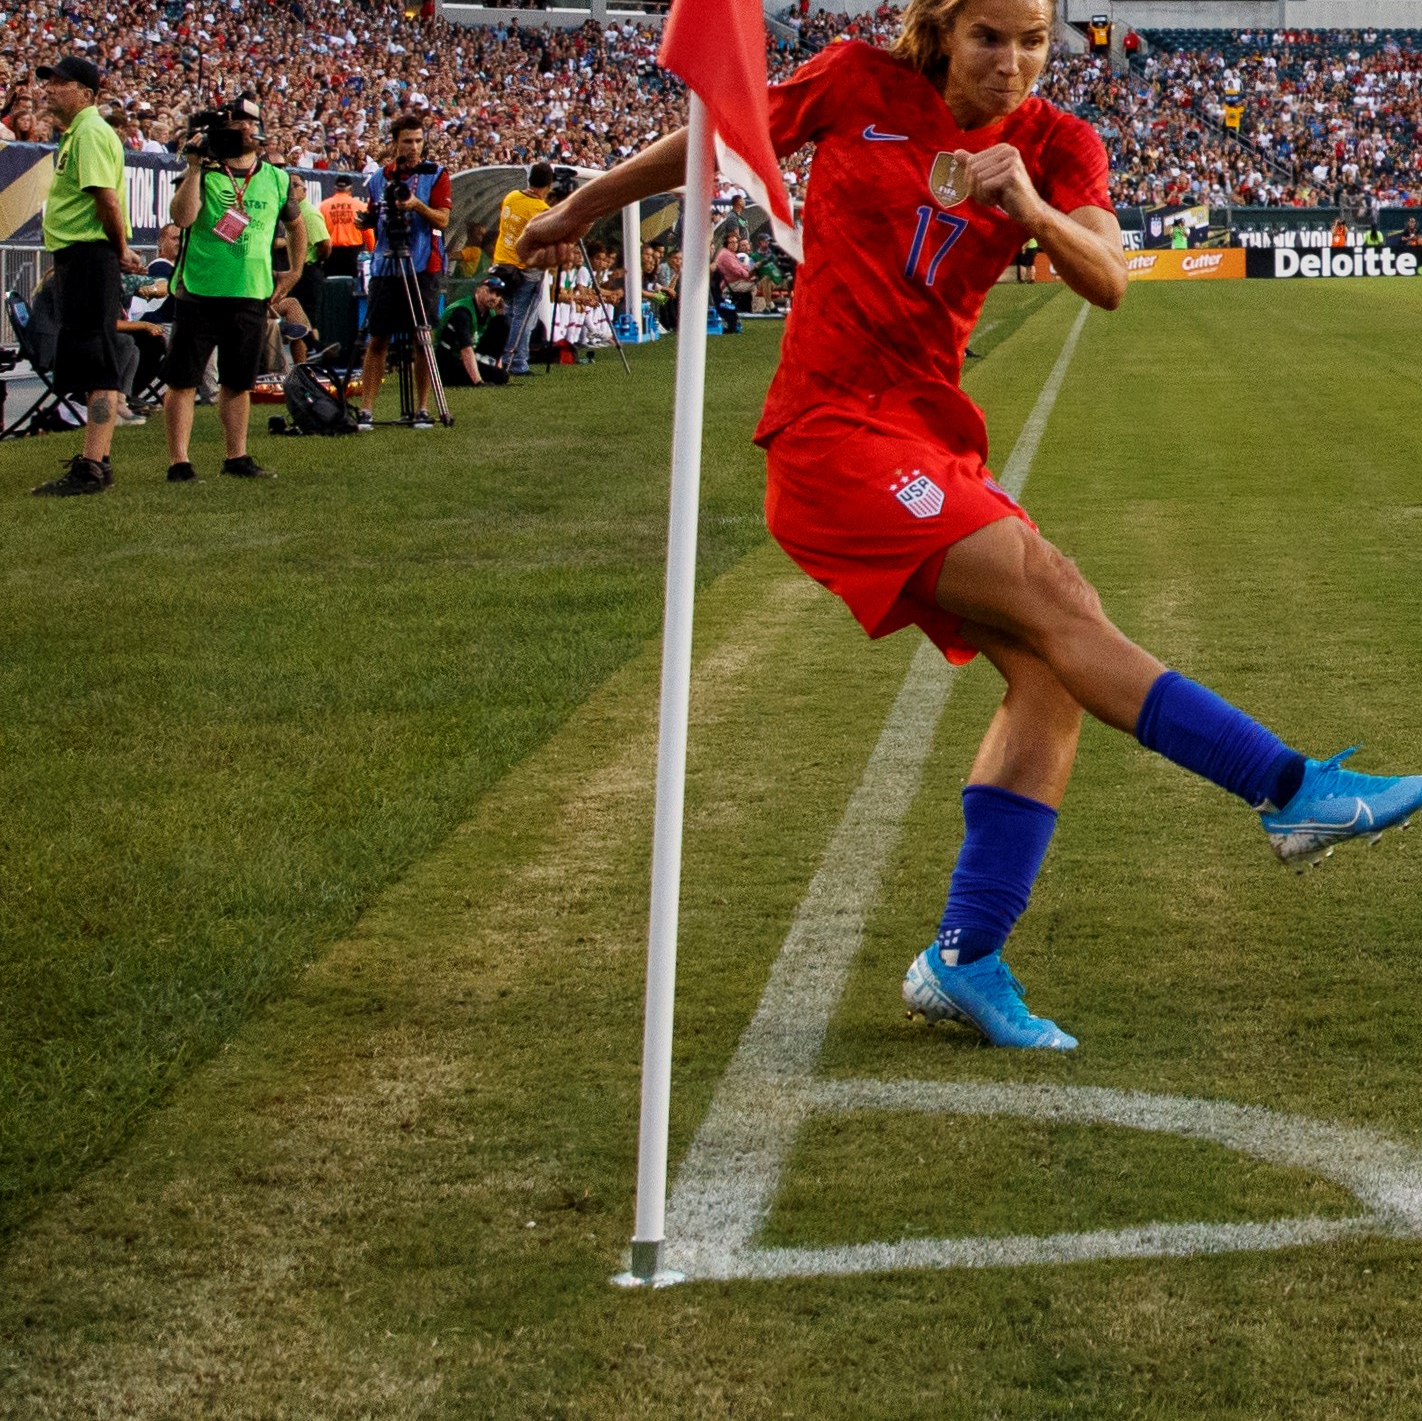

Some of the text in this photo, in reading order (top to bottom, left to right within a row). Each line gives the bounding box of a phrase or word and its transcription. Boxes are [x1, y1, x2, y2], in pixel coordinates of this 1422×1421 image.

[125, 165, 157, 229] TION.
[939, 185, 957, 197] FIFA
[242, 199, 268, 210] AT&T
[904, 205, 968, 286] 17
[1181, 254, 1223, 270] Cutter
[900, 477, 929, 502] USA
